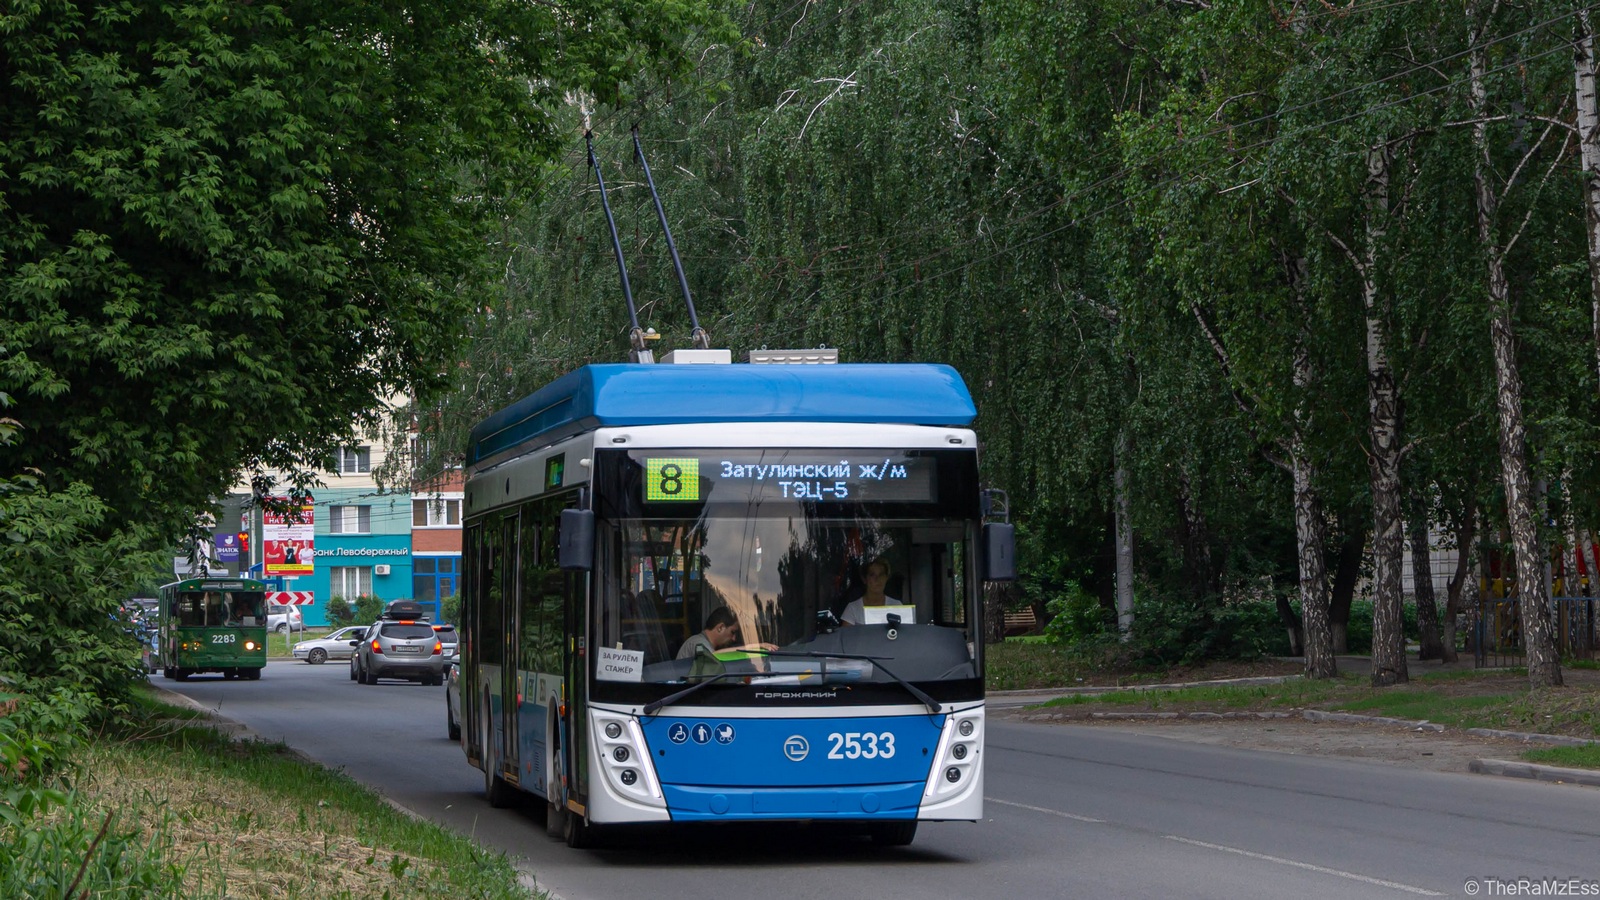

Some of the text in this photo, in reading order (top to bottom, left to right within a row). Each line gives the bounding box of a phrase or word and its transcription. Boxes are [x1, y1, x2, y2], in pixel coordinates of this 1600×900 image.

[720, 458, 907, 480] Затулинский ж/м
[660, 463, 683, 495] 8
[779, 481, 849, 500] ТЭЦ-5
[336, 547, 408, 557] Левобережный
[212, 634, 236, 644] 2283
[603, 651, 639, 663] ЗА РУЛЁМ
[604, 664, 634, 674] СТАЖЁР
[827, 732, 896, 760] 2533
